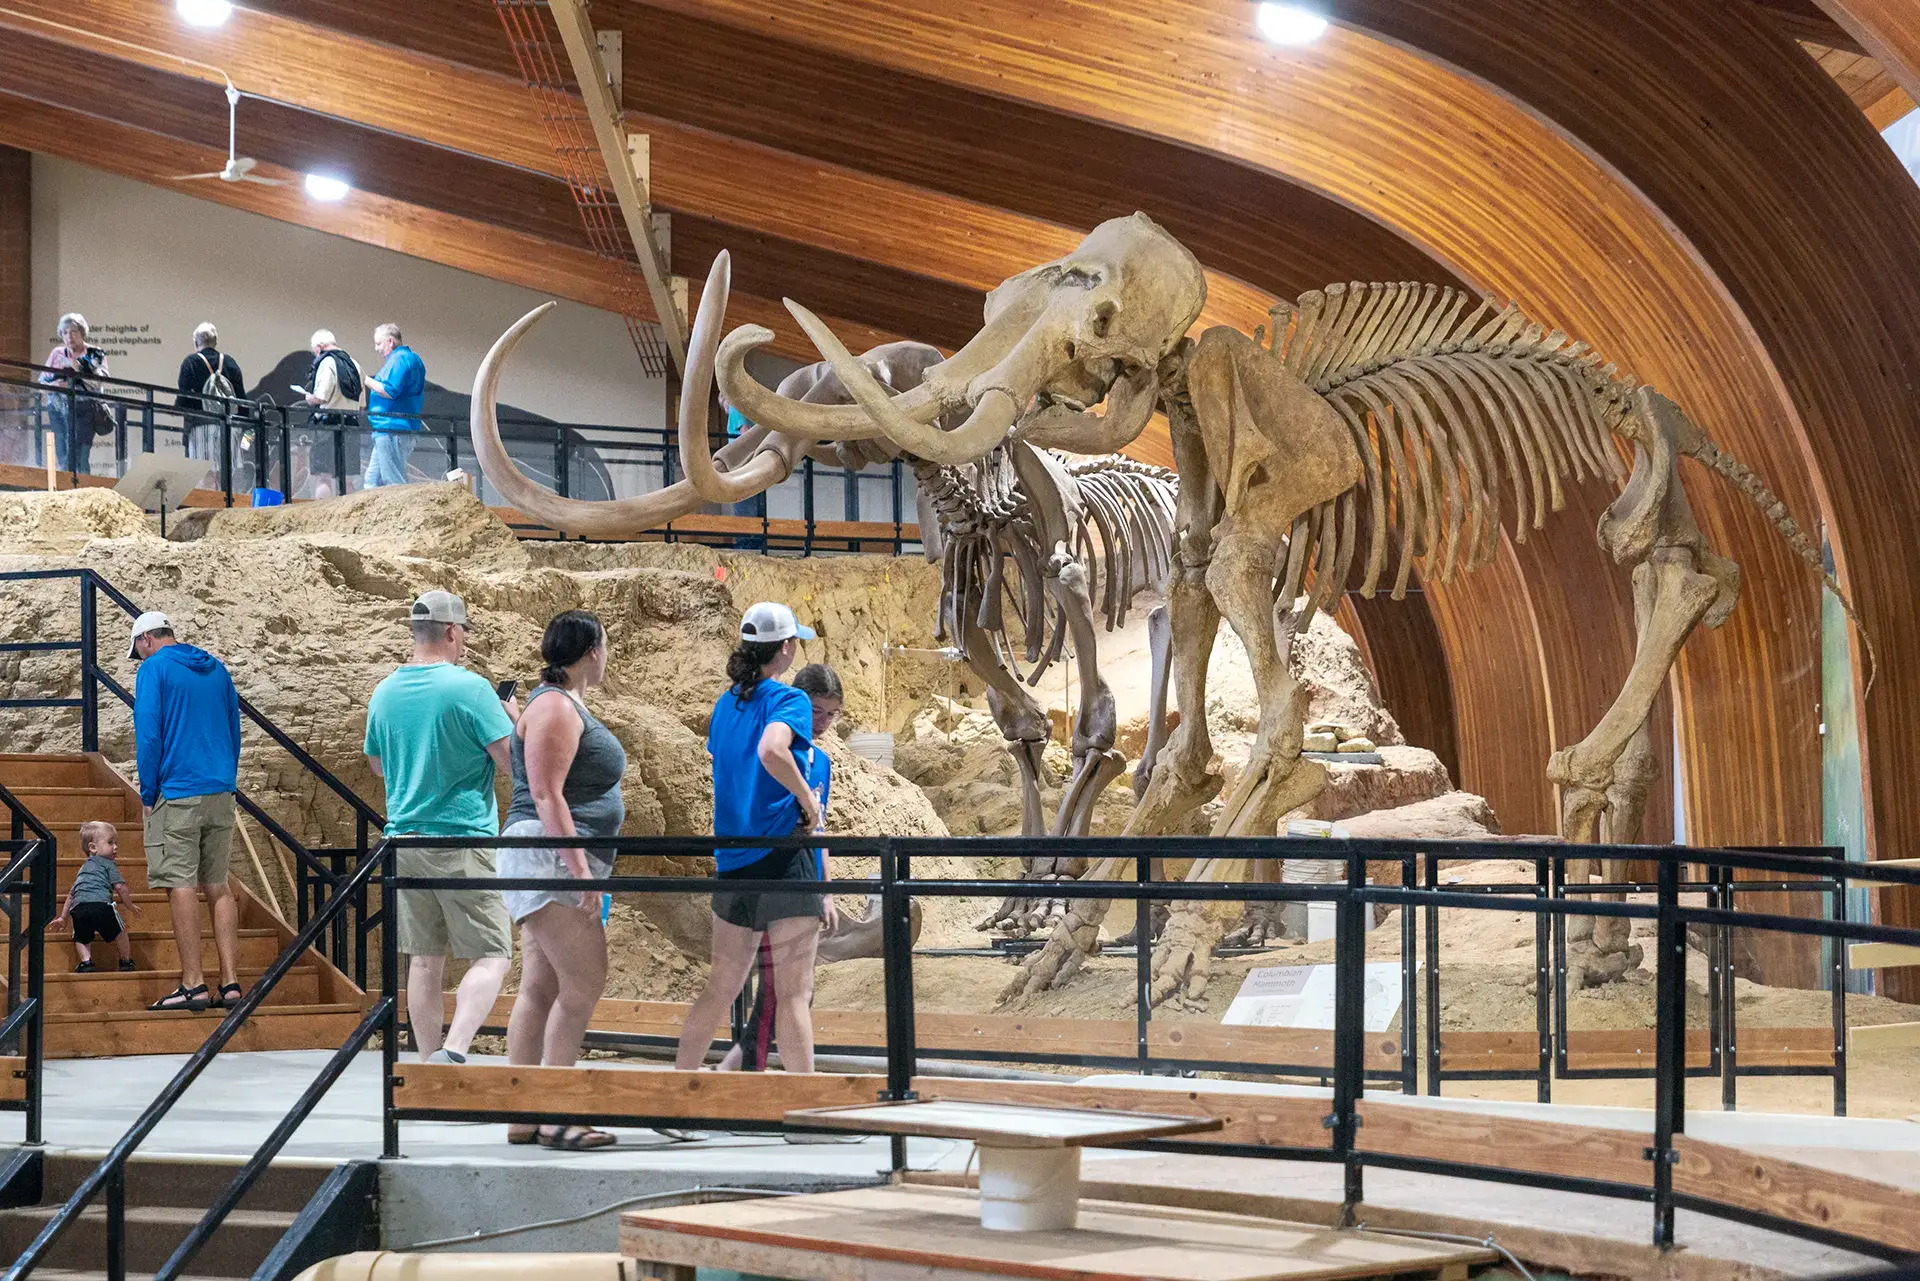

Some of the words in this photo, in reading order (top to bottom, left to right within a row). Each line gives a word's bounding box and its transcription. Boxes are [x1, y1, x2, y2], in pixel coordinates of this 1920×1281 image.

[105, 324, 138, 334] heights
[140, 324, 150, 332] of
[101, 336, 118, 344] and
[119, 336, 162, 346] elephants
[1257, 969, 1303, 979] Columbian
[1252, 980, 1296, 988] Mammoth
